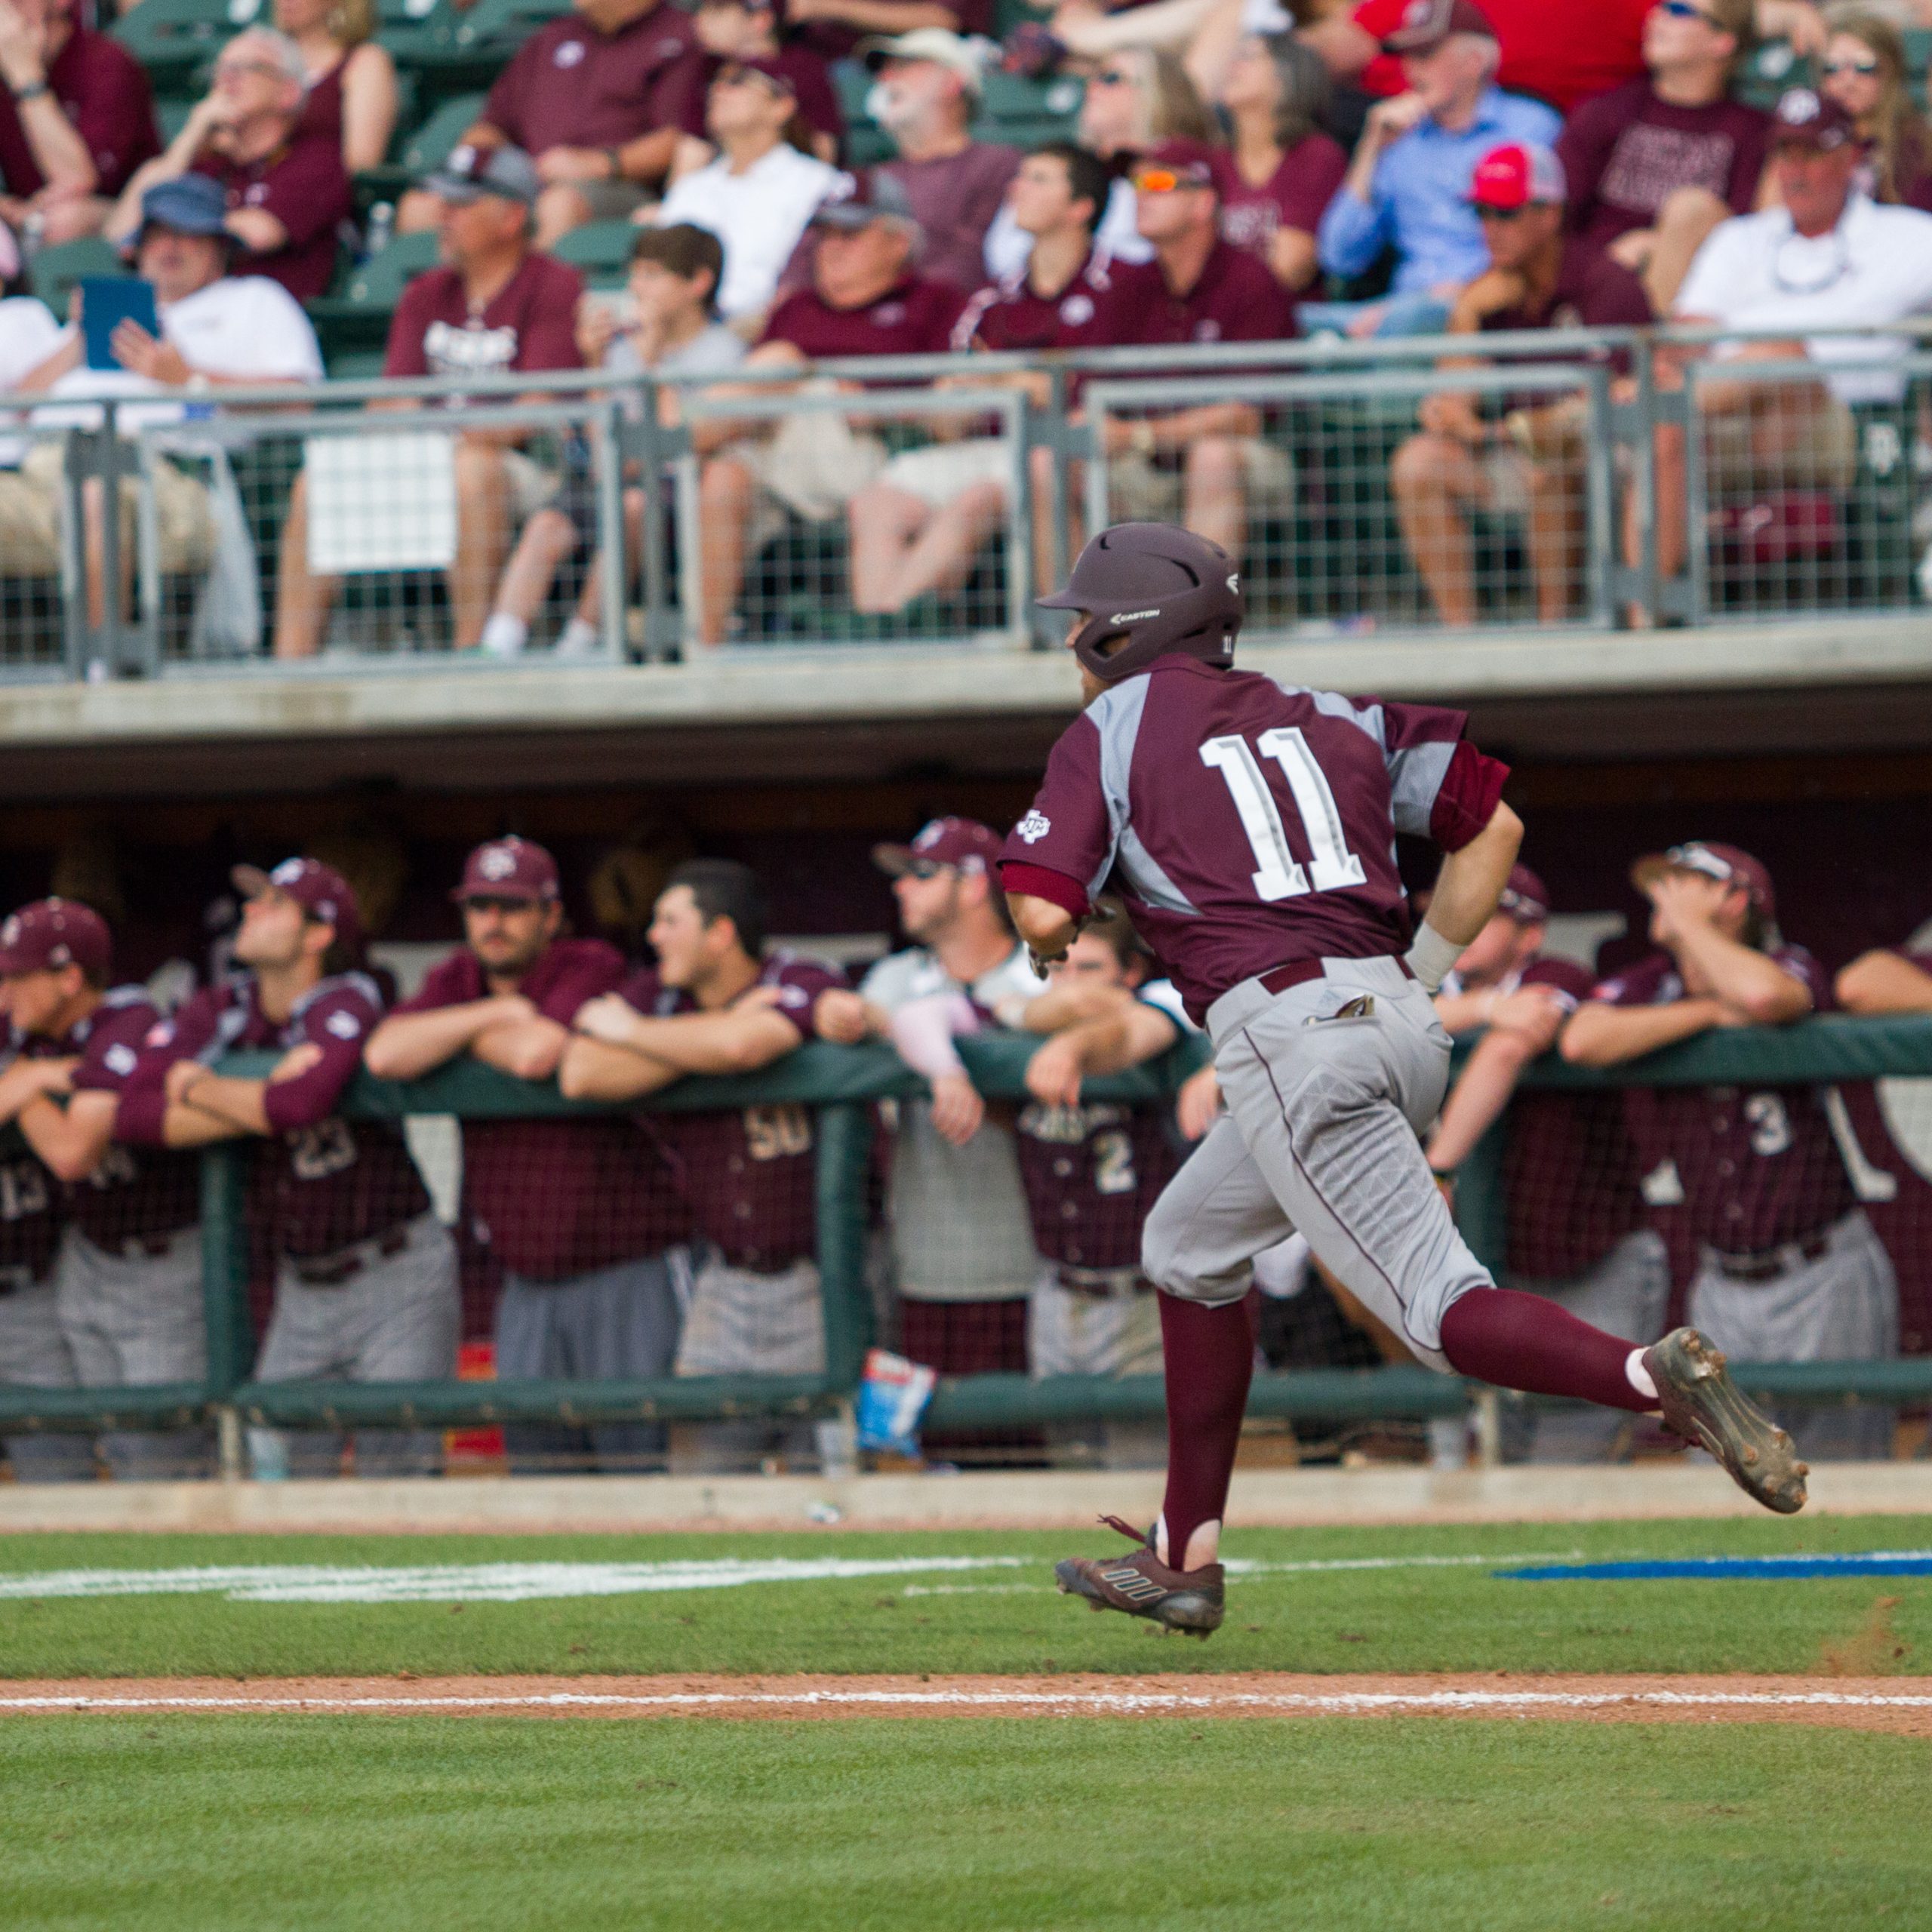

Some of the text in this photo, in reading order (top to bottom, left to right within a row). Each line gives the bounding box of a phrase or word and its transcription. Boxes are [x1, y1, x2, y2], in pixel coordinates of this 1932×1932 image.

[1121, 609, 1160, 622] EASTON
[1223, 635, 1232, 654] 11
[1198, 726, 1367, 902] 11
[1745, 1093, 1789, 1156] 3
[1094, 1131, 1137, 1195] 2
